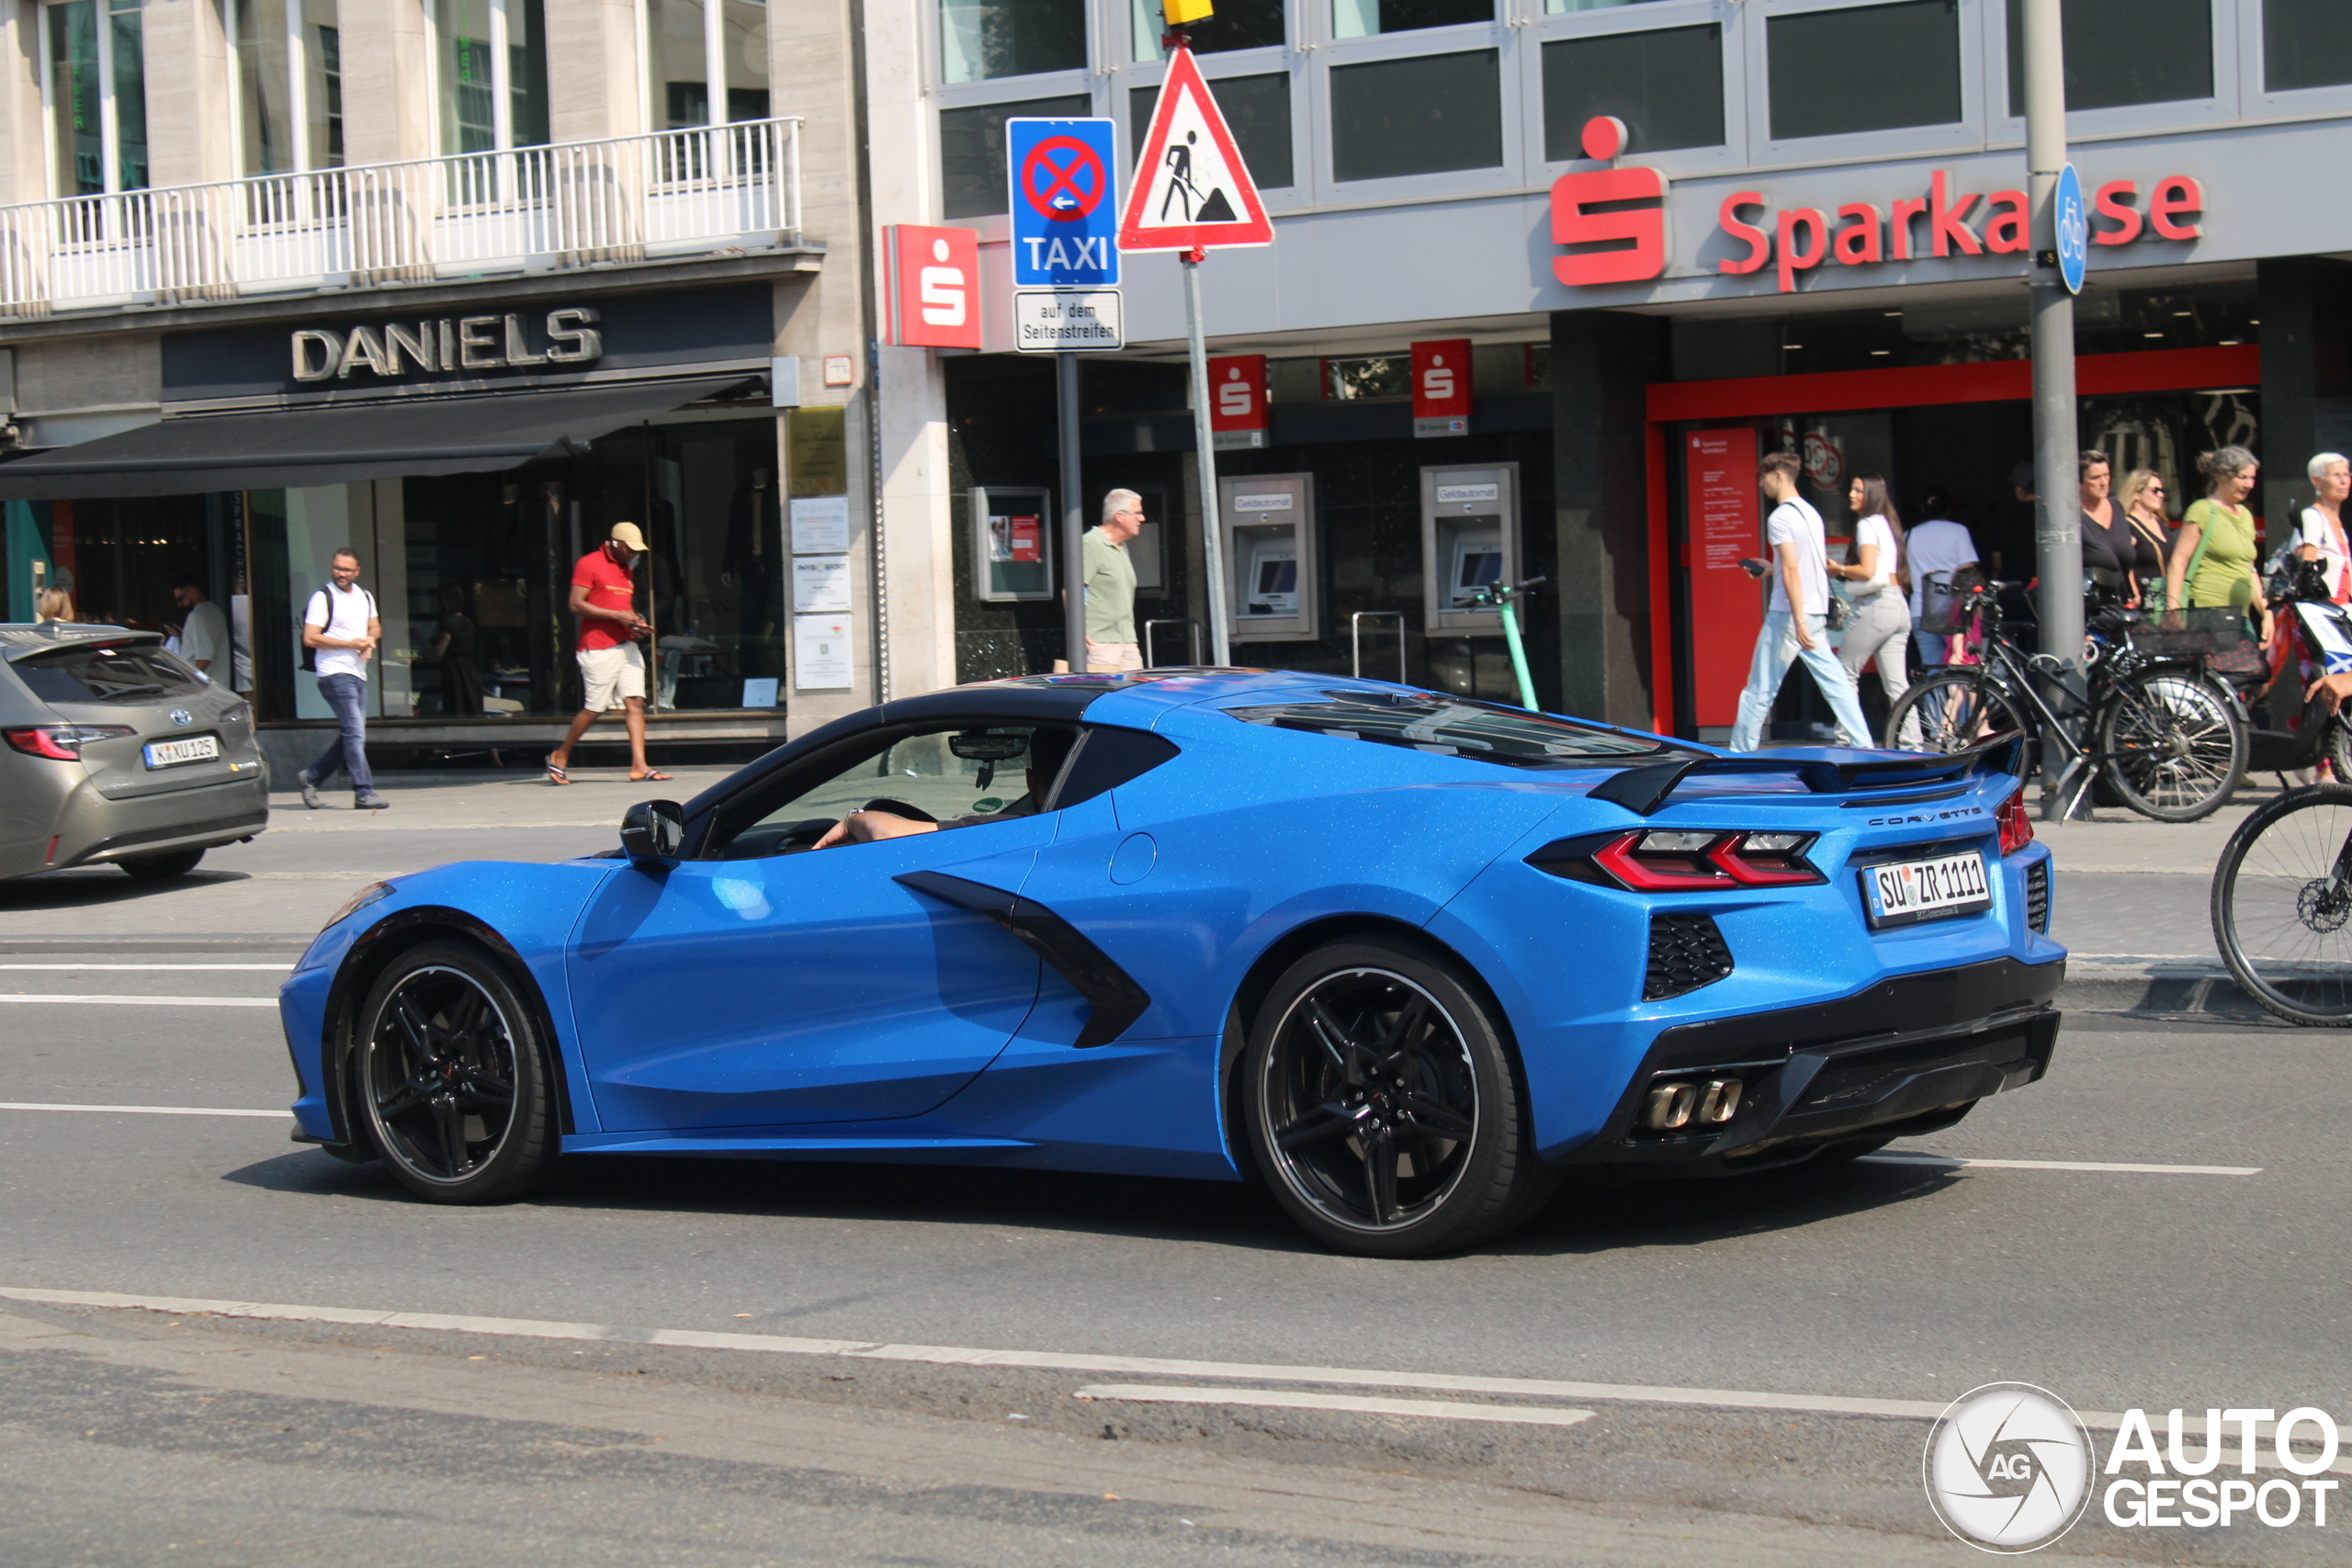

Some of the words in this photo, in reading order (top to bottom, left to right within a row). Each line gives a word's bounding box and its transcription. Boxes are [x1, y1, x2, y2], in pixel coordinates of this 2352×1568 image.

[1718, 169, 2207, 292] Sparkase
[1023, 236, 1108, 271] TAXI
[1040, 302, 1062, 318] auf
[1069, 302, 1096, 318] dem
[1023, 322, 1114, 340] Seitenstreifen
[291, 308, 603, 382] DANIELS
[1237, 498, 1291, 509] Geldautomat
[1440, 489, 1496, 500] Geldautomat
[155, 745, 167, 762] K
[172, 742, 189, 760] XU
[189, 739, 213, 757] 125
[1869, 807, 1983, 826] CORVETTE
[1879, 870, 1907, 909] SU
[1914, 865, 1942, 904] ZR
[1940, 859, 1985, 899] 1111
[1872, 897, 1880, 909] D
